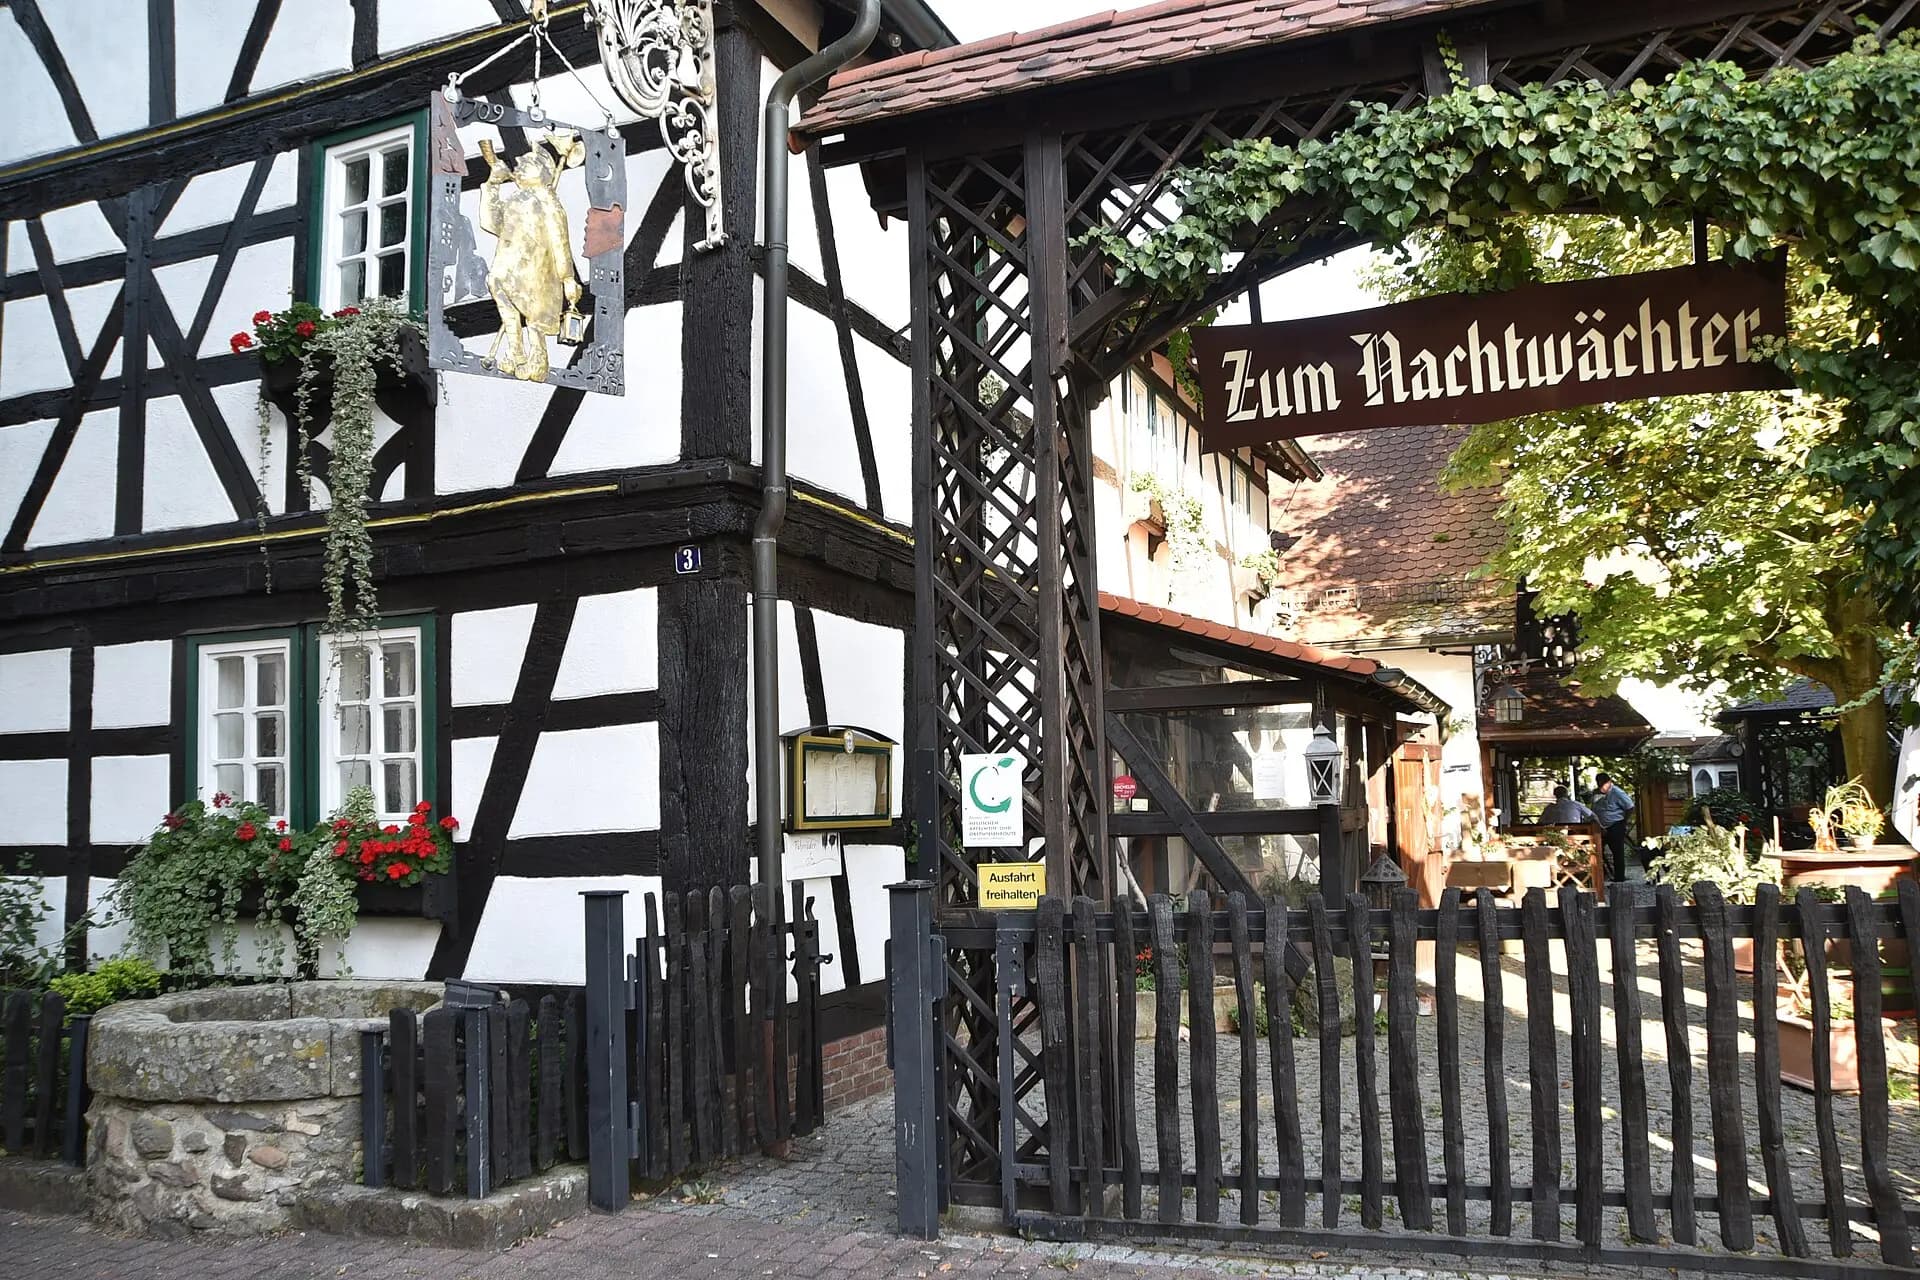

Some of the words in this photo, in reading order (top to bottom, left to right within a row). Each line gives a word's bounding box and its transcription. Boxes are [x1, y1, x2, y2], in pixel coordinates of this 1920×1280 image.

[1221, 349, 1341, 423] Zum
[1350, 297, 1761, 407] Nachtwächter
[683, 549, 693, 570] 3
[989, 872, 1036, 883] Ausfahrt
